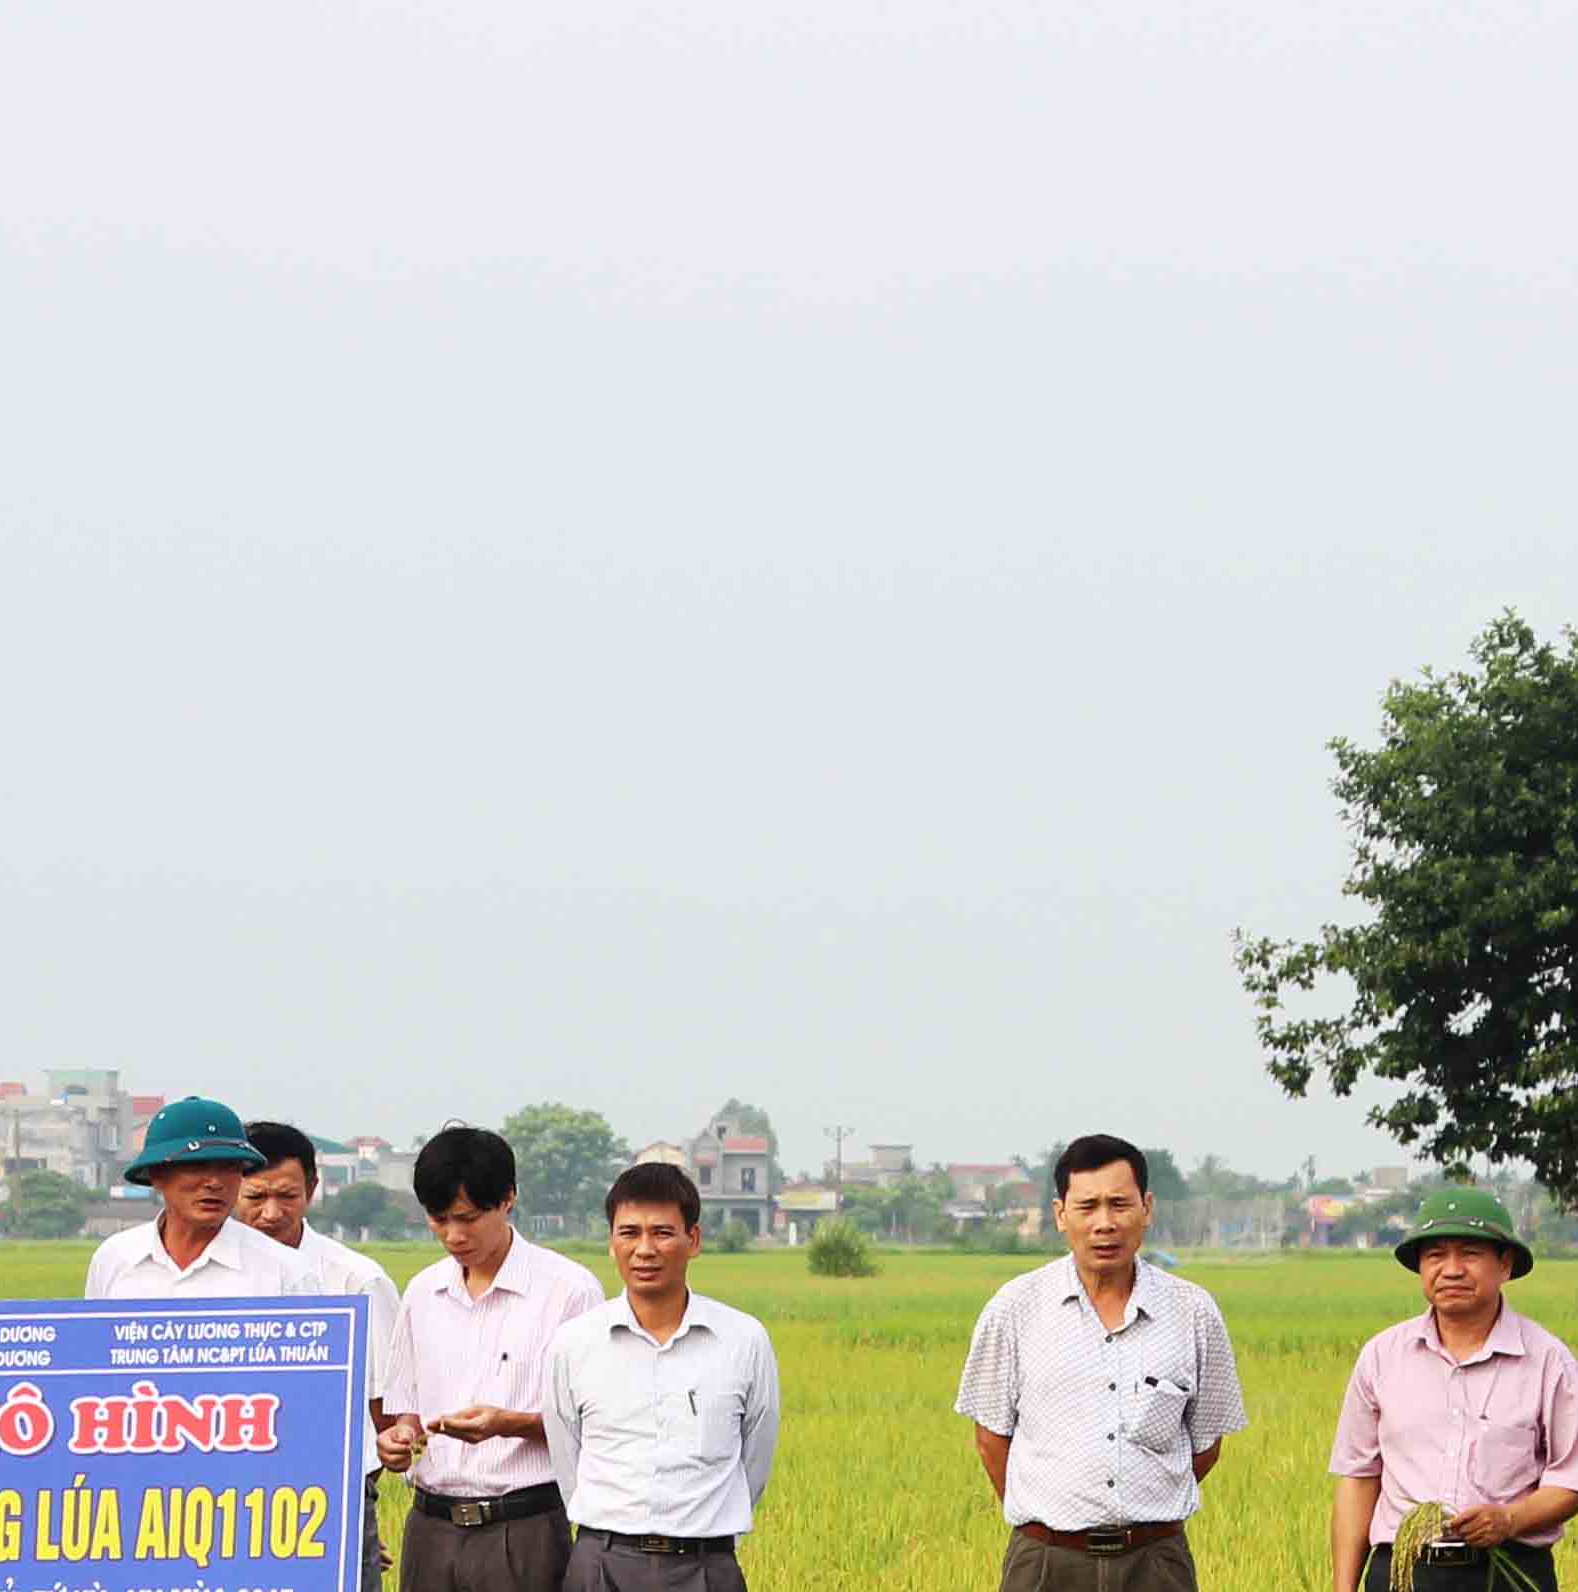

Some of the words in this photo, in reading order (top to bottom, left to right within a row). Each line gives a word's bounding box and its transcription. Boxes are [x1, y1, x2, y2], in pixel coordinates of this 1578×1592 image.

[0, 1325, 56, 1342] DƯƠNG
[115, 1321, 148, 1344] VIỆN
[151, 1320, 184, 1340] CÂY
[188, 1322, 240, 1339] LƯƠNG
[244, 1322, 282, 1341] THỰC
[285, 1321, 296, 1338] &
[300, 1321, 327, 1337] CTP
[111, 1348, 159, 1364] TRUNG
[163, 1344, 193, 1363] TÂM
[197, 1347, 245, 1363] NC&PT
[249, 1342, 276, 1362] LÚA
[69, 1382, 279, 1452] HÌNH
[34, 1473, 122, 1560] LÚA
[134, 1486, 328, 1567] AIQ1102
